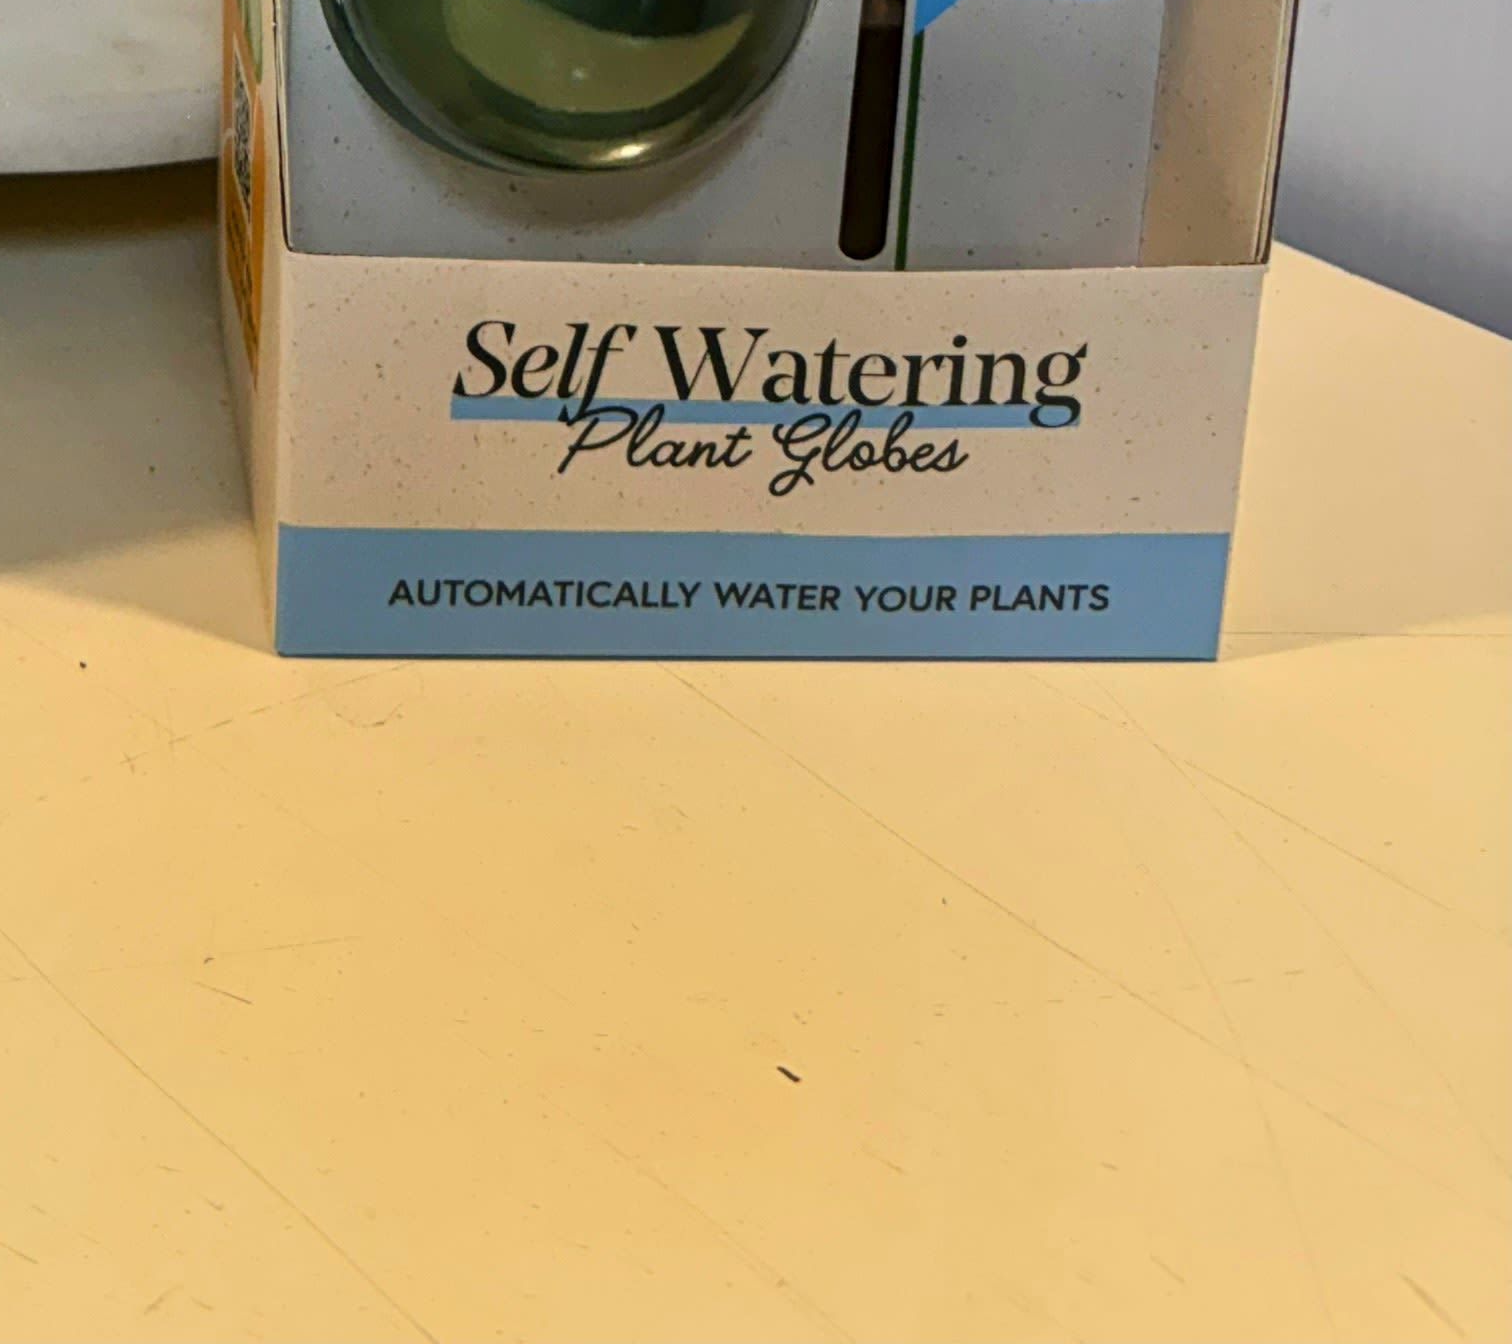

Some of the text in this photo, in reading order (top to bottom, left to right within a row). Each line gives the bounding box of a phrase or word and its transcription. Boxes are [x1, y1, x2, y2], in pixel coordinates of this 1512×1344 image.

[451, 320, 1089, 427] Self Watering
[557, 405, 969, 497] Plant Globes
[388, 579, 1110, 613] AUTOMATICALLY WATER YOUR PLANTS
